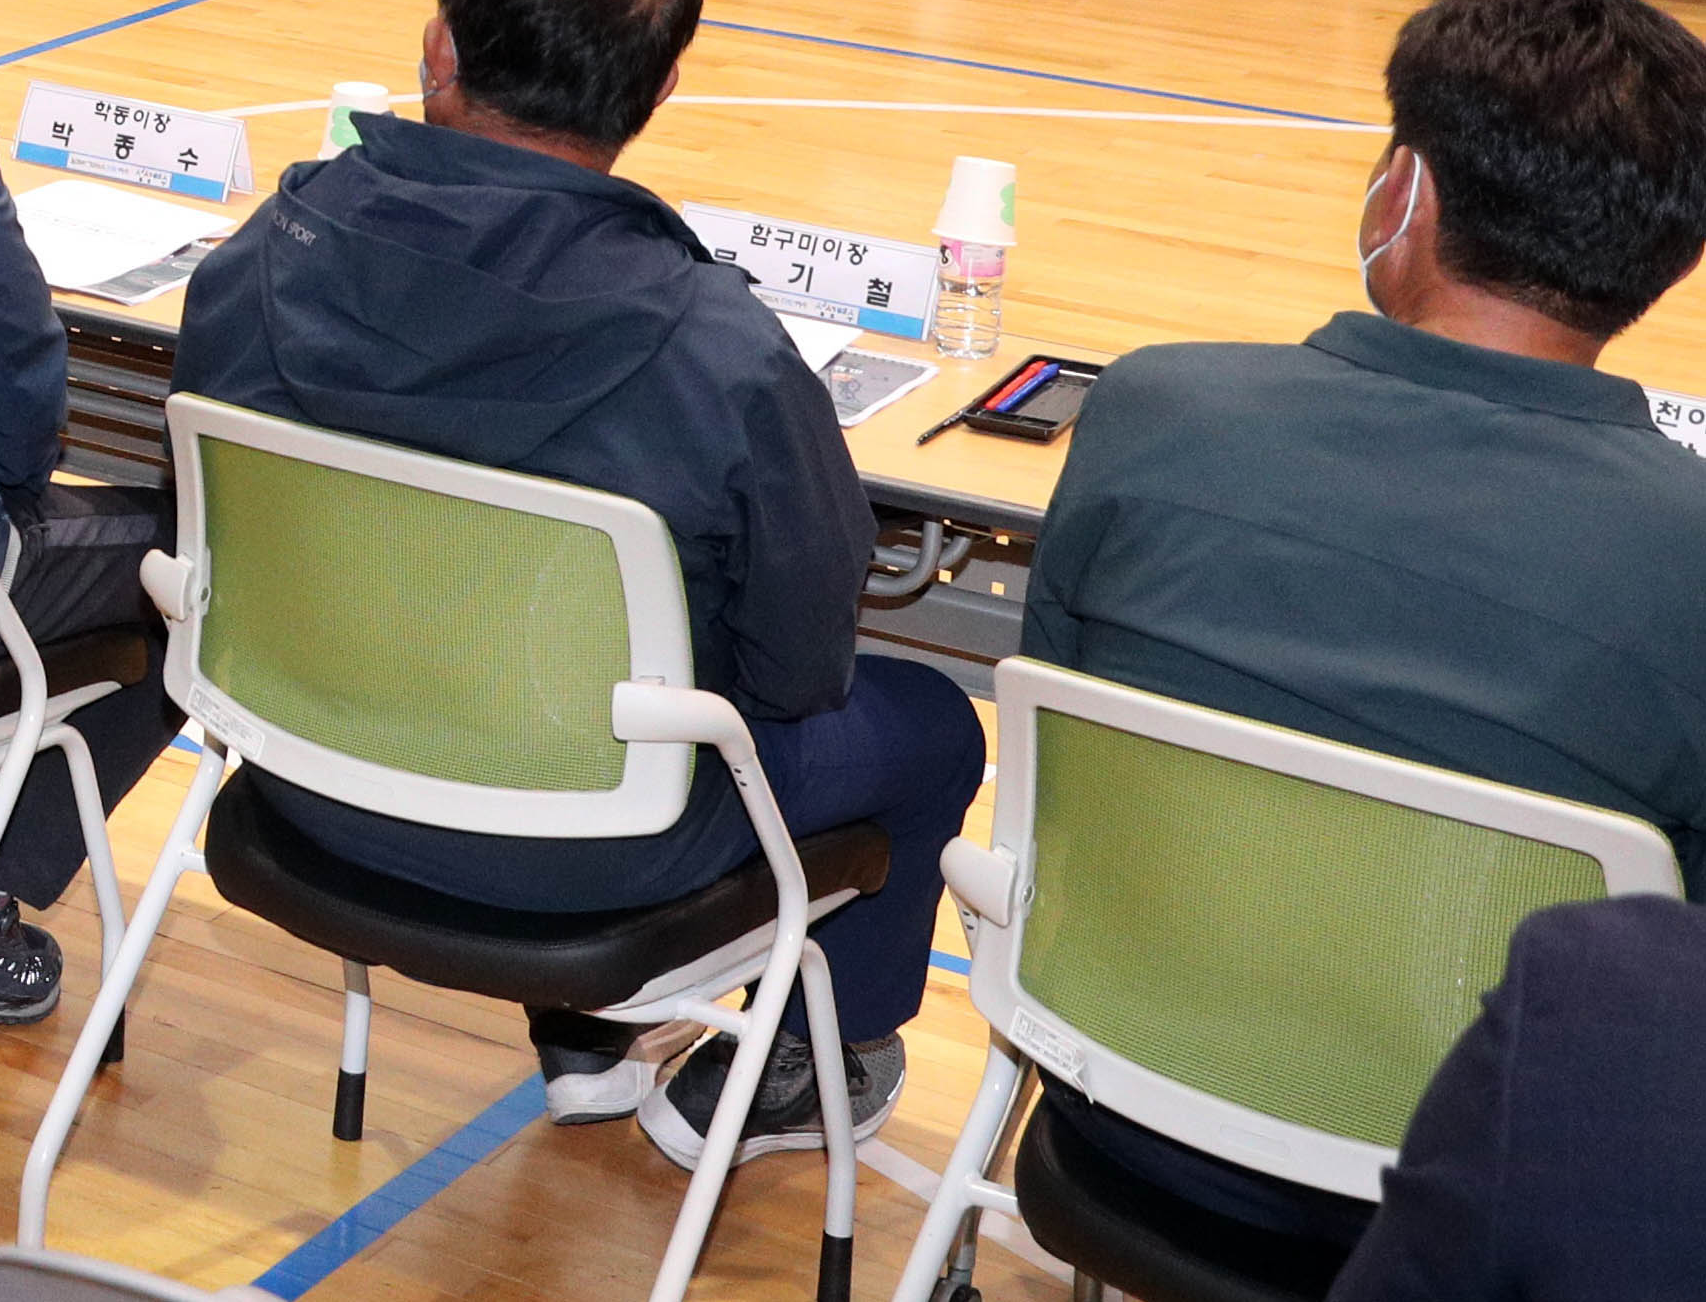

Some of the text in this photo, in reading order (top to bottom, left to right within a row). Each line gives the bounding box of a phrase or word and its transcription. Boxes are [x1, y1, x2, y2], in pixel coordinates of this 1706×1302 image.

[94, 100, 171, 134] 학동이장
[51, 121, 200, 173] 박 종 수
[750, 223, 869, 267] 함구미이장
[787, 263, 893, 308] 기 철
